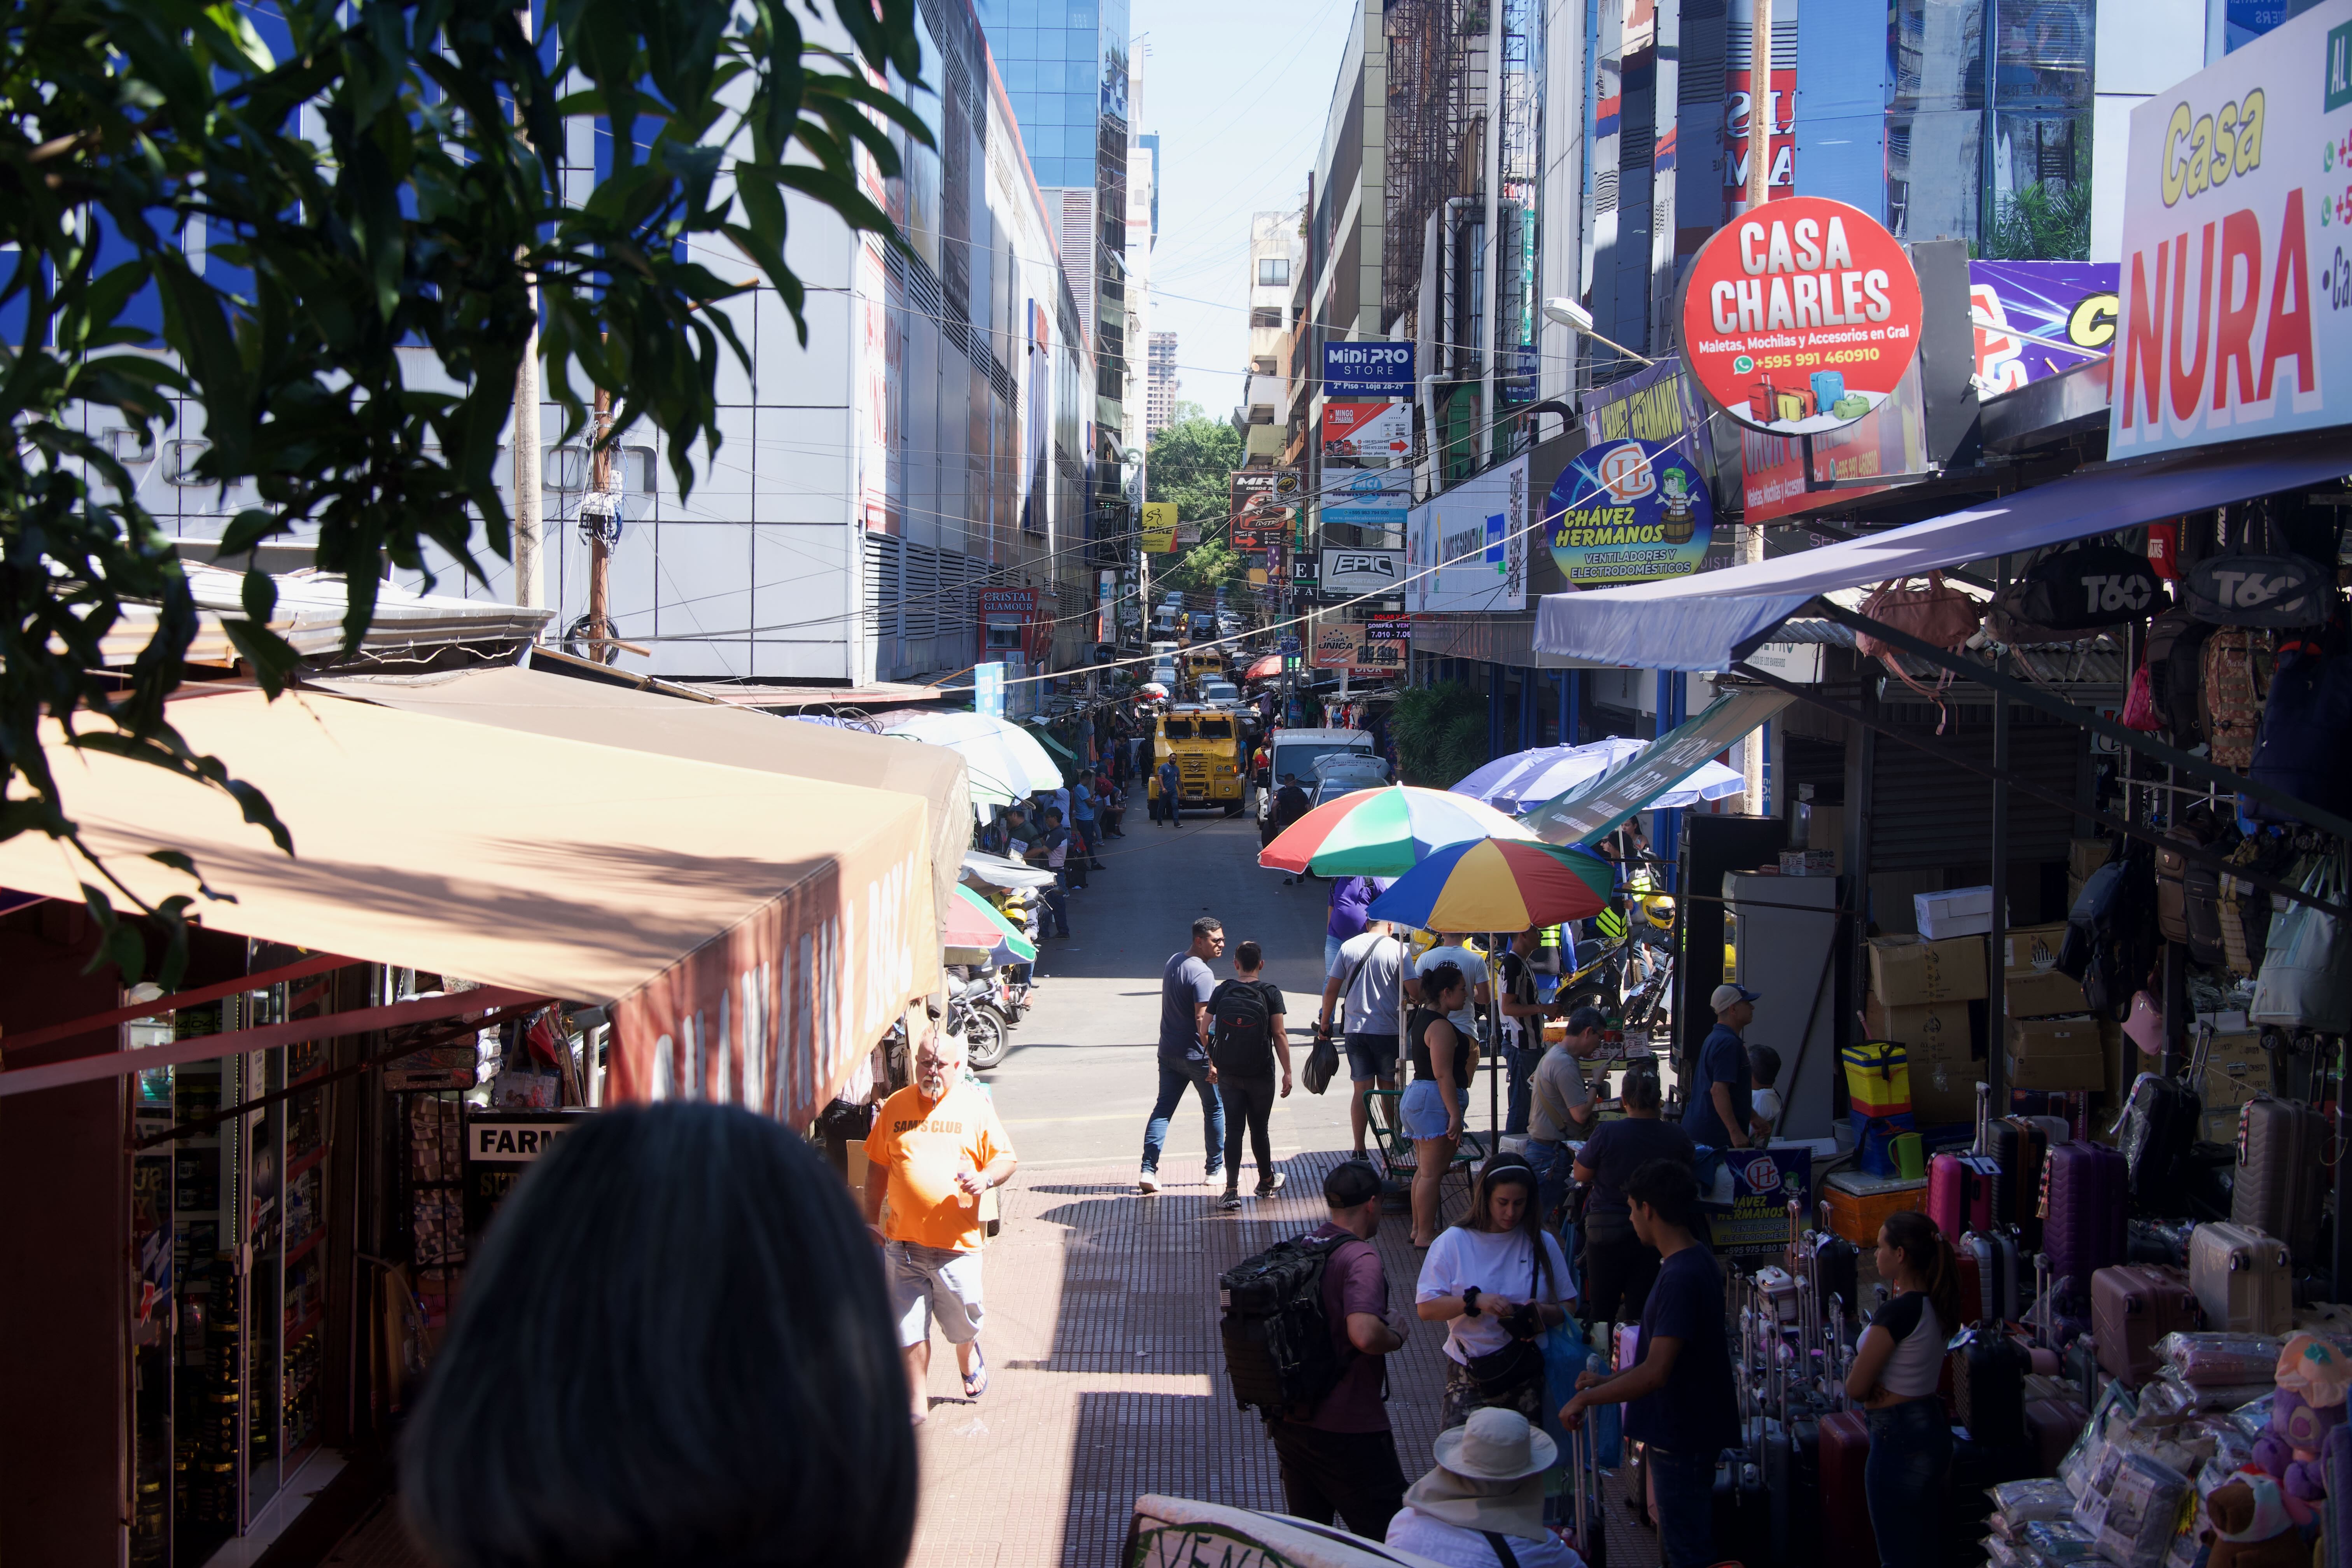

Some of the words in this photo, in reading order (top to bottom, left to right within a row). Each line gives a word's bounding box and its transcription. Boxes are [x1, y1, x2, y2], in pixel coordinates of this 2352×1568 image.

[2162, 87, 2265, 208] Casa
[1739, 216, 1853, 276] CASA
[1710, 269, 1892, 335] CHARLES
[2121, 187, 2316, 429] NURA
[1699, 340, 1745, 354] Maletas,
[1748, 334, 1796, 350] Mochilas
[1799, 337, 1805, 348] y
[1808, 329, 1868, 345] Accesorios
[1871, 331, 1885, 340] en
[1886, 324, 1909, 339] Gral
[1370, 349, 1409, 364] PRO
[1755, 354, 1792, 369] +595
[1795, 352, 1820, 366] 991
[1825, 348, 1880, 364] 460910
[1344, 366, 1393, 375] STORE
[1366, 382, 1381, 391] Loja
[1629, 372, 1682, 441] HERMANOS
[1836, 457, 1848, 479] +595
[1858, 450, 1878, 477] 460910
[1355, 479, 1379, 488] MCI
[1747, 485, 1764, 509] Maletas,
[1763, 478, 1781, 504] Mochilas
[1563, 505, 1636, 528] CHÁVEZ
[1555, 524, 1665, 548] HERMANOS
[1585, 550, 1667, 564] VENTILADORES
[1667, 549, 1677, 559] Y
[2147, 539, 2163, 558] VANS
[1335, 556, 1393, 575] EPIC
[1570, 560, 1691, 578] ELECTRODOMÉSTICOS
[984, 592, 1034, 601] CRISTAL
[2081, 574, 2151, 614] T60
[2212, 570, 2305, 612] T60
[893, 1120, 928, 1133] SAM'S
[931, 1120, 962, 1134] CLUB
[1731, 1222, 1790, 1233] VENTILADORES
